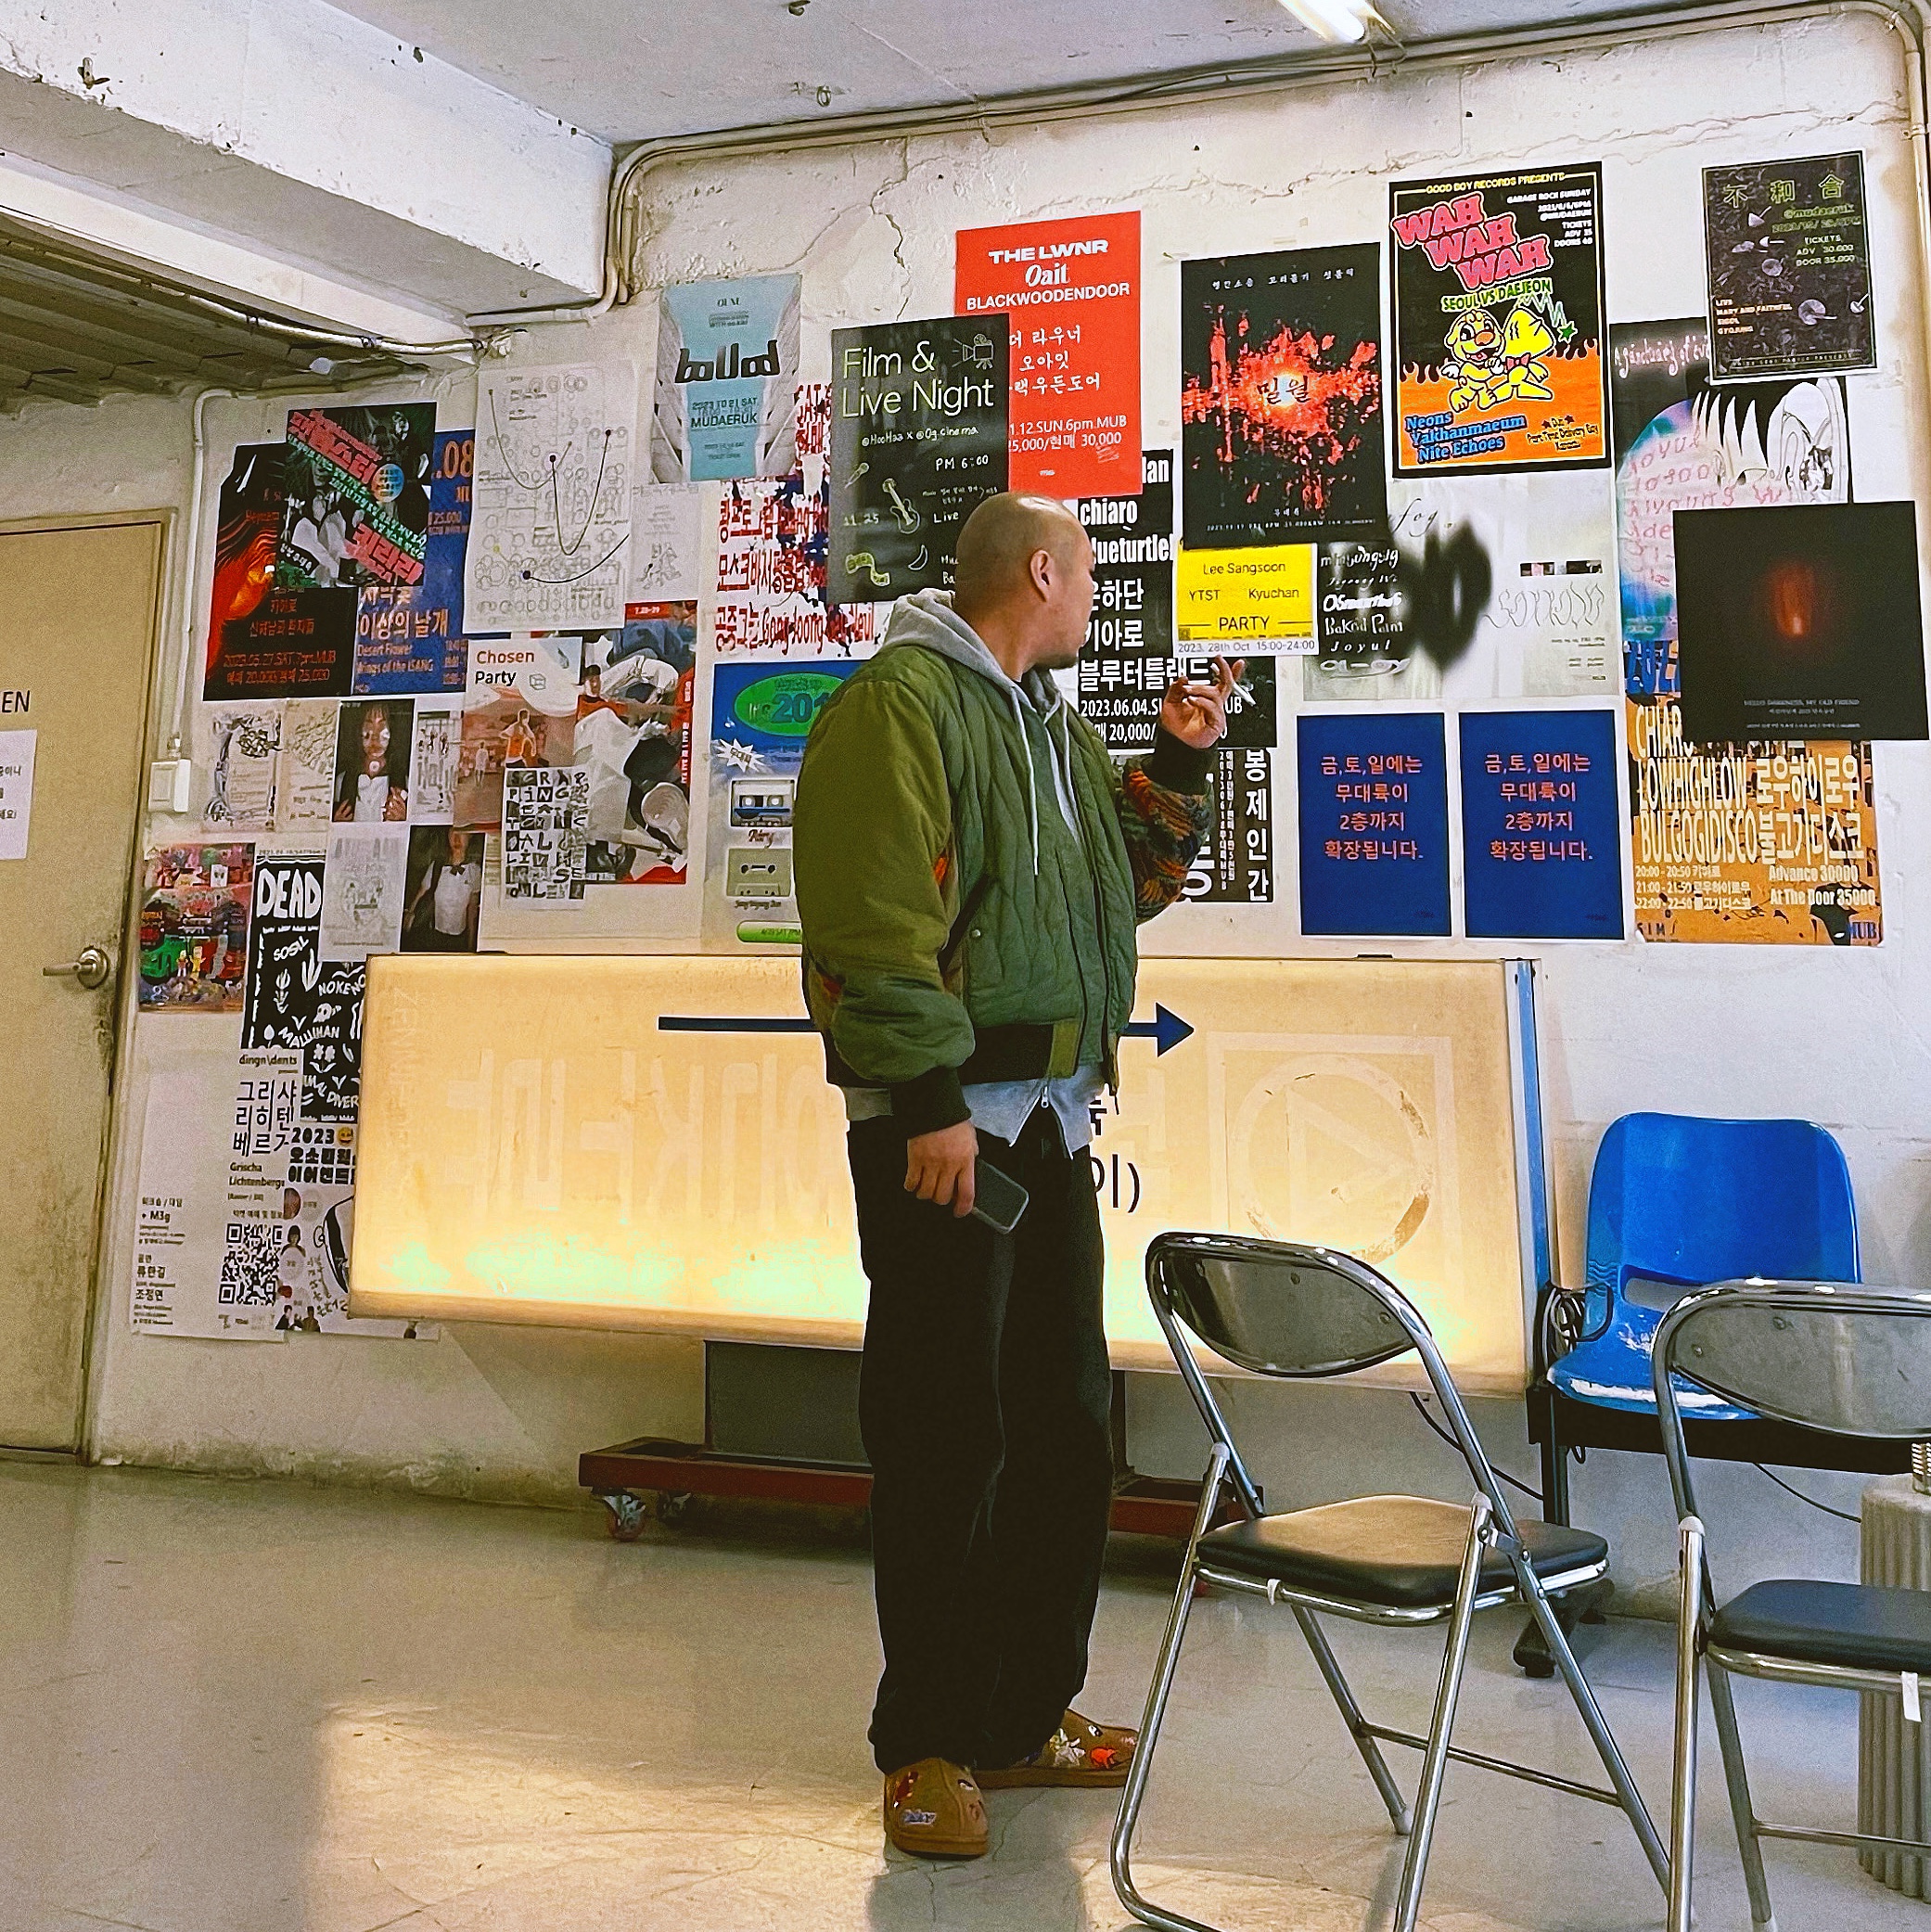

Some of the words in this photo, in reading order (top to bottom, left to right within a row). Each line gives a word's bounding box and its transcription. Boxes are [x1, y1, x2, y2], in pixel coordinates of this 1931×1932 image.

[1474, 176, 1516, 190] RECORDS
[1392, 194, 1483, 247] WAH
[988, 246, 1036, 264] THE
[1039, 239, 1108, 260] LWNR
[1425, 215, 1516, 269] WAH
[1797, 247, 1816, 256] ADV
[1457, 236, 1553, 290] WAH
[1796, 257, 1822, 267] DOOR
[966, 282, 1130, 311] BLACKWOODENDOOR
[1441, 291, 1477, 313] SEOUL
[1478, 288, 1498, 307] VS
[1498, 277, 1553, 304] DAEJEON
[1031, 325, 1081, 346] 라우너
[842, 346, 902, 380] Film
[911, 339, 936, 374] &
[1019, 352, 1069, 372] 오아잇
[1009, 372, 1101, 397] 랙우든도어
[842, 388, 902, 418] Live
[912, 376, 995, 416] Night
[690, 411, 758, 429] MUDAERUK
[1405, 412, 1453, 431] Neons
[1081, 431, 1122, 446] 30,000
[1418, 445, 1450, 463] Nite
[1451, 436, 1505, 458] Echoes
[935, 456, 955, 471] PM
[932, 510, 959, 525] Live
[1081, 499, 1138, 528] chiaro
[1203, 563, 1224, 575] Lee
[1226, 562, 1286, 576] Sangsoon
[1189, 589, 1221, 601] YTST
[1248, 587, 1299, 601] Kyuchan
[359, 609, 410, 641] 이상의
[415, 608, 448, 638] 날개
[1219, 616, 1271, 632] PARTY
[476, 650, 535, 665] Chosen
[1208, 641, 1231, 652] 28th
[474, 670, 518, 687] Party
[1635, 705, 1694, 759] CHIAR
[1320, 754, 1424, 777] 금,토,일에는
[1484, 752, 1592, 774] 금,토,일에는
[1336, 783, 1409, 803] 무대륙이
[1500, 780, 1577, 802] 무대륙이
[1636, 756, 1749, 811] LOWHIGHLOW
[1756, 754, 1861, 811] 로우하이로우
[1244, 748, 1270, 902] 봉제인간
[1339, 811, 1406, 832] 2층까지
[1505, 810, 1574, 832] 2층까지
[1640, 809, 1758, 864] BULGOGIDISCO
[1758, 810, 1865, 865] 불고기디스코
[1324, 838, 1424, 861] 확장됩니다.
[1490, 838, 1594, 862] 확장됩니다.
[1635, 865, 1660, 877] 20:00
[1666, 865, 1691, 877] 20:50
[1768, 864, 1818, 881] Advance
[1820, 864, 1859, 881] 30000
[256, 867, 322, 919] DEAD
[1770, 889, 1784, 905] At
[1785, 889, 1806, 905] The
[1807, 888, 1835, 905] Door
[1836, 888, 1875, 906] 35000
[237, 1079, 298, 1111] 그리샤
[235, 1105, 295, 1132] 리히텐
[289, 1126, 335, 1145] 2023
[229, 1161, 262, 1174] Grischa
